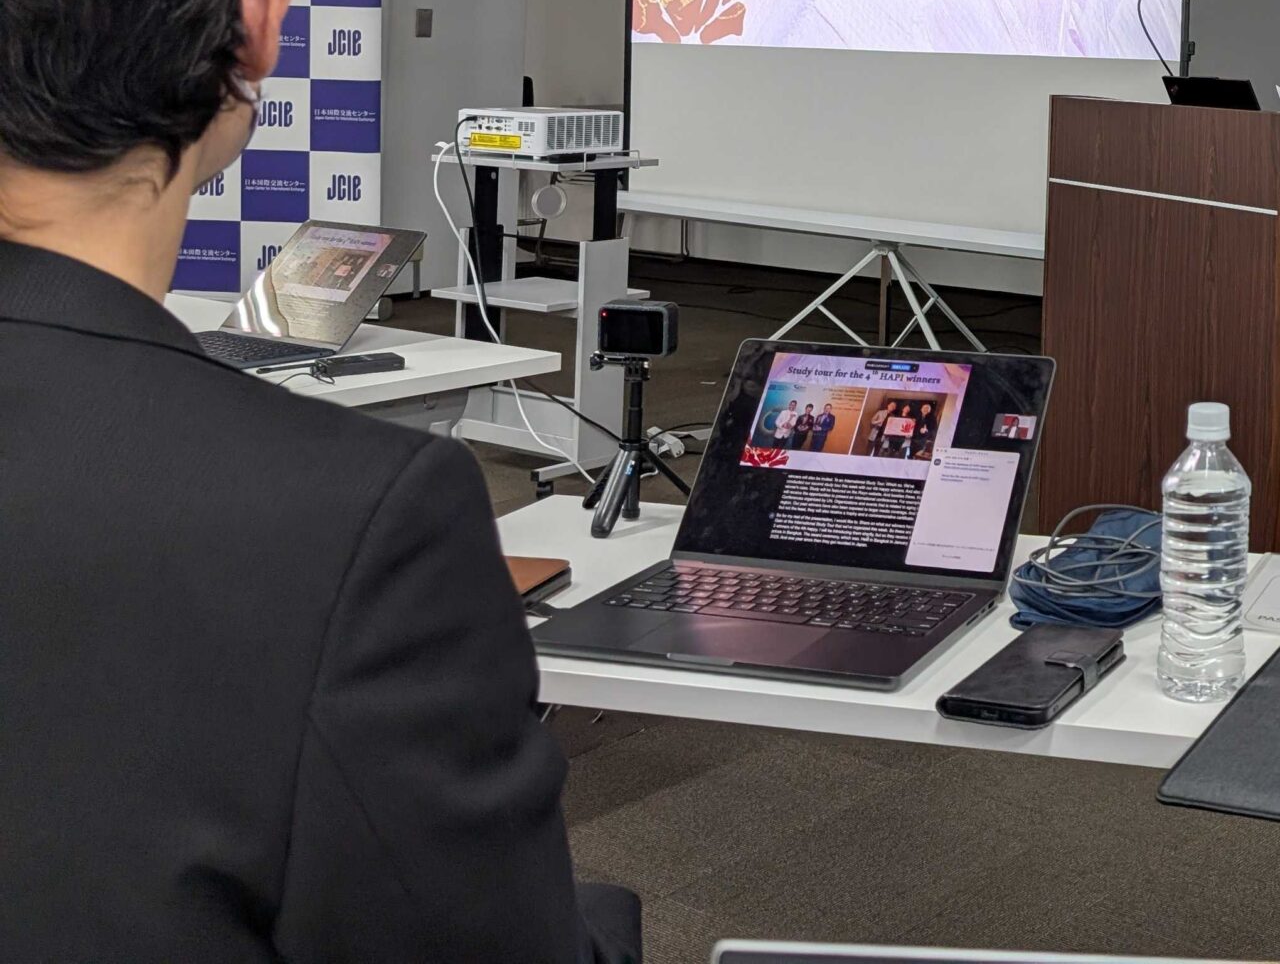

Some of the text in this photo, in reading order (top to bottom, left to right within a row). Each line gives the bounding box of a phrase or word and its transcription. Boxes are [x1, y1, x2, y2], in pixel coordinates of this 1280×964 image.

[787, 366, 812, 378] Study
[814, 368, 832, 377] tour
[833, 368, 848, 378] for
[849, 370, 863, 379] the
[879, 372, 904, 382] HAPI
[905, 375, 941, 384] winners
